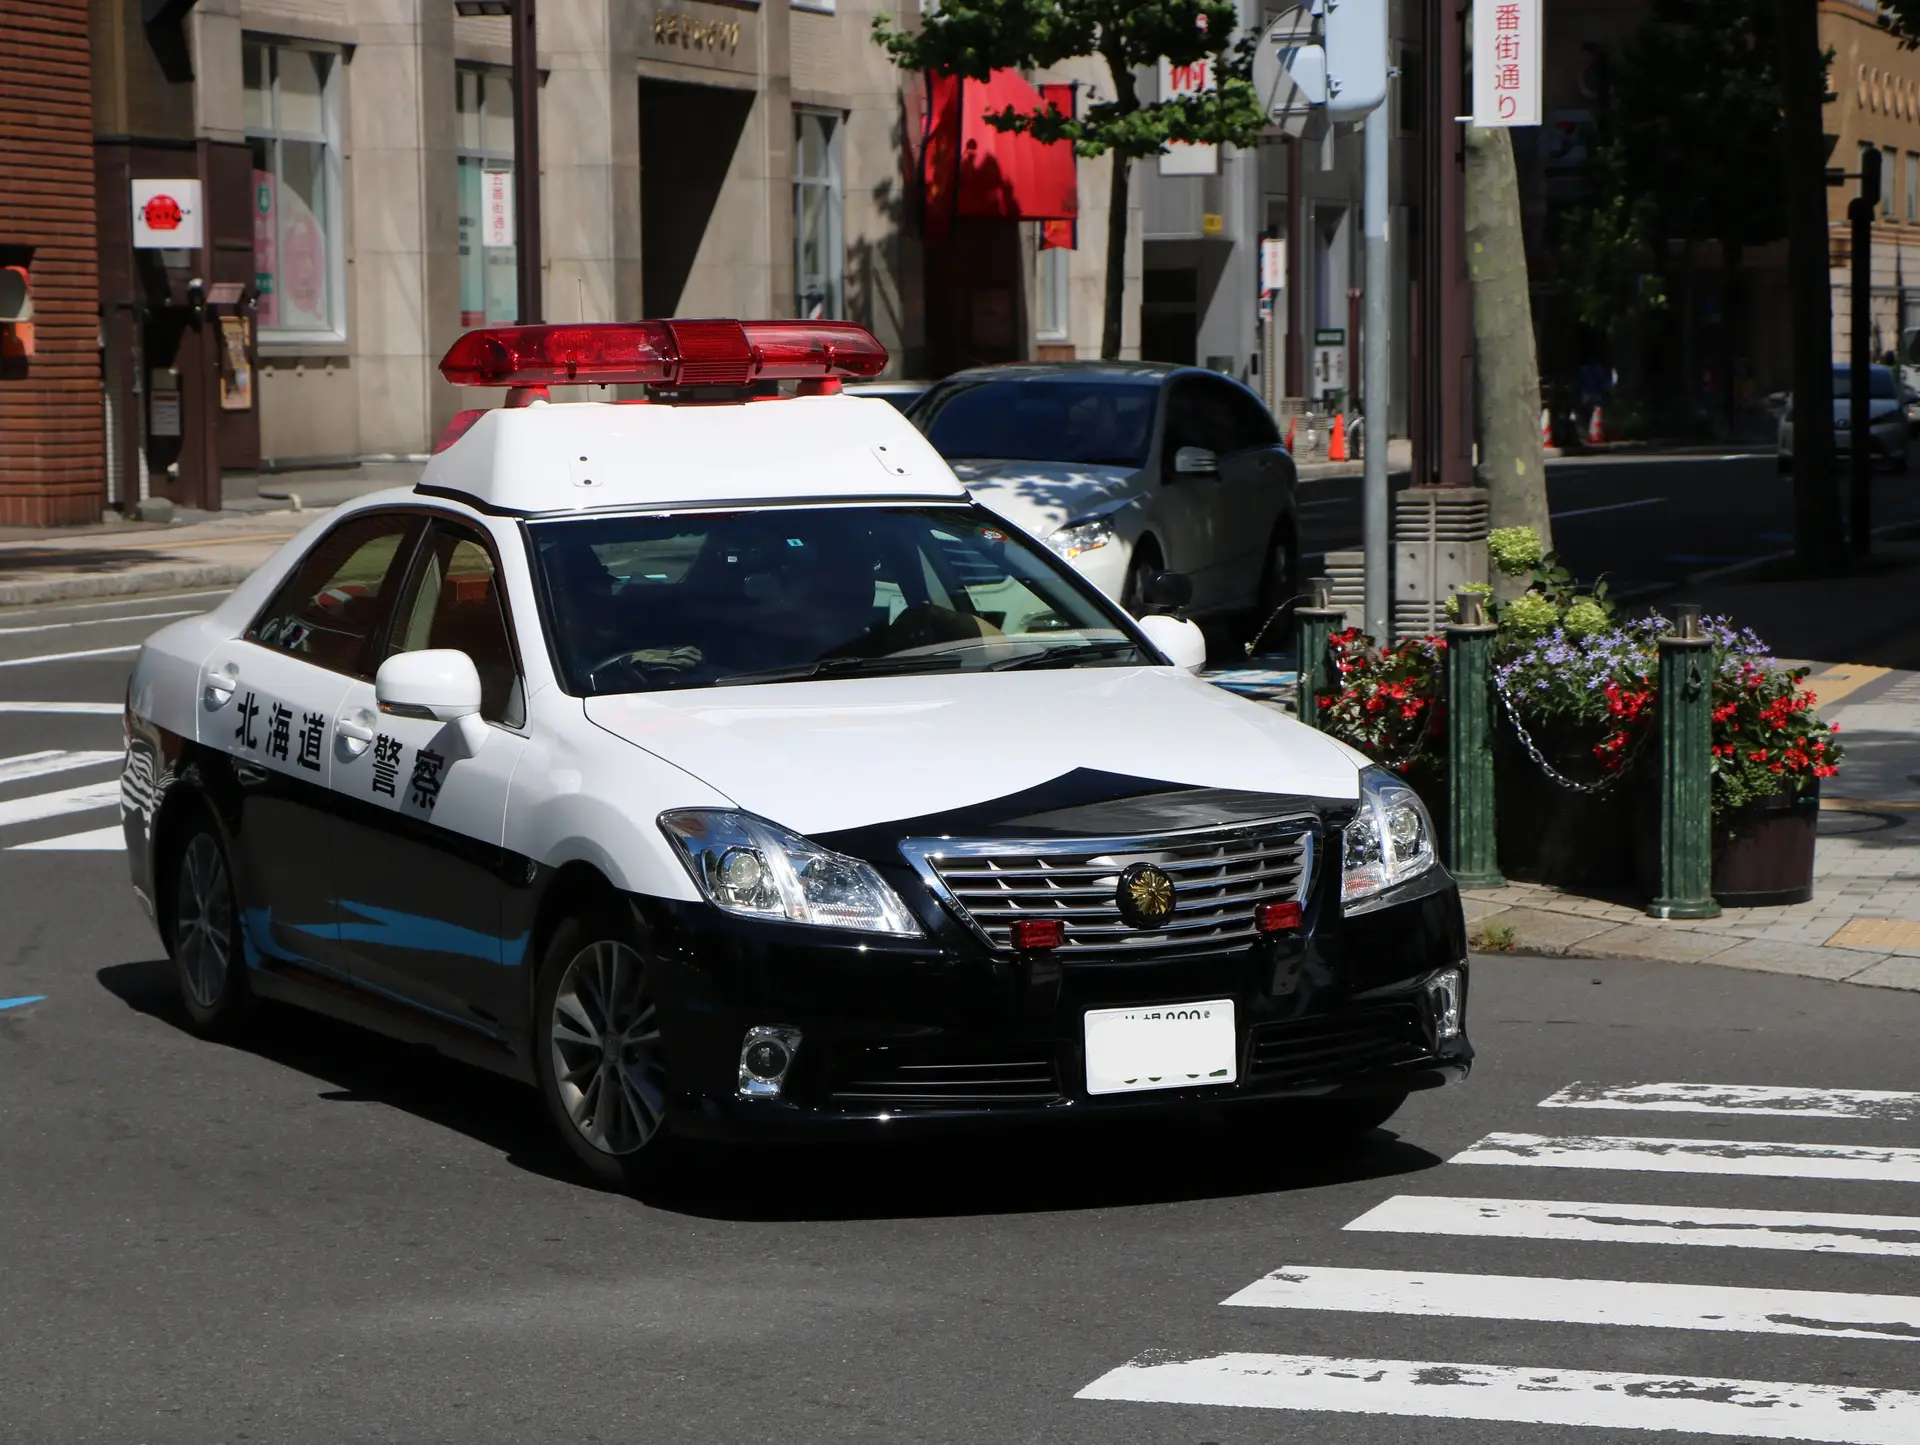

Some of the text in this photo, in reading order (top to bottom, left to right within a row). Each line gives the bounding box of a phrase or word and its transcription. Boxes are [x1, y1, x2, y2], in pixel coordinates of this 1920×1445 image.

[1495, 3, 1521, 119] 番街通り
[235, 692, 445, 809] 北海道 警察
